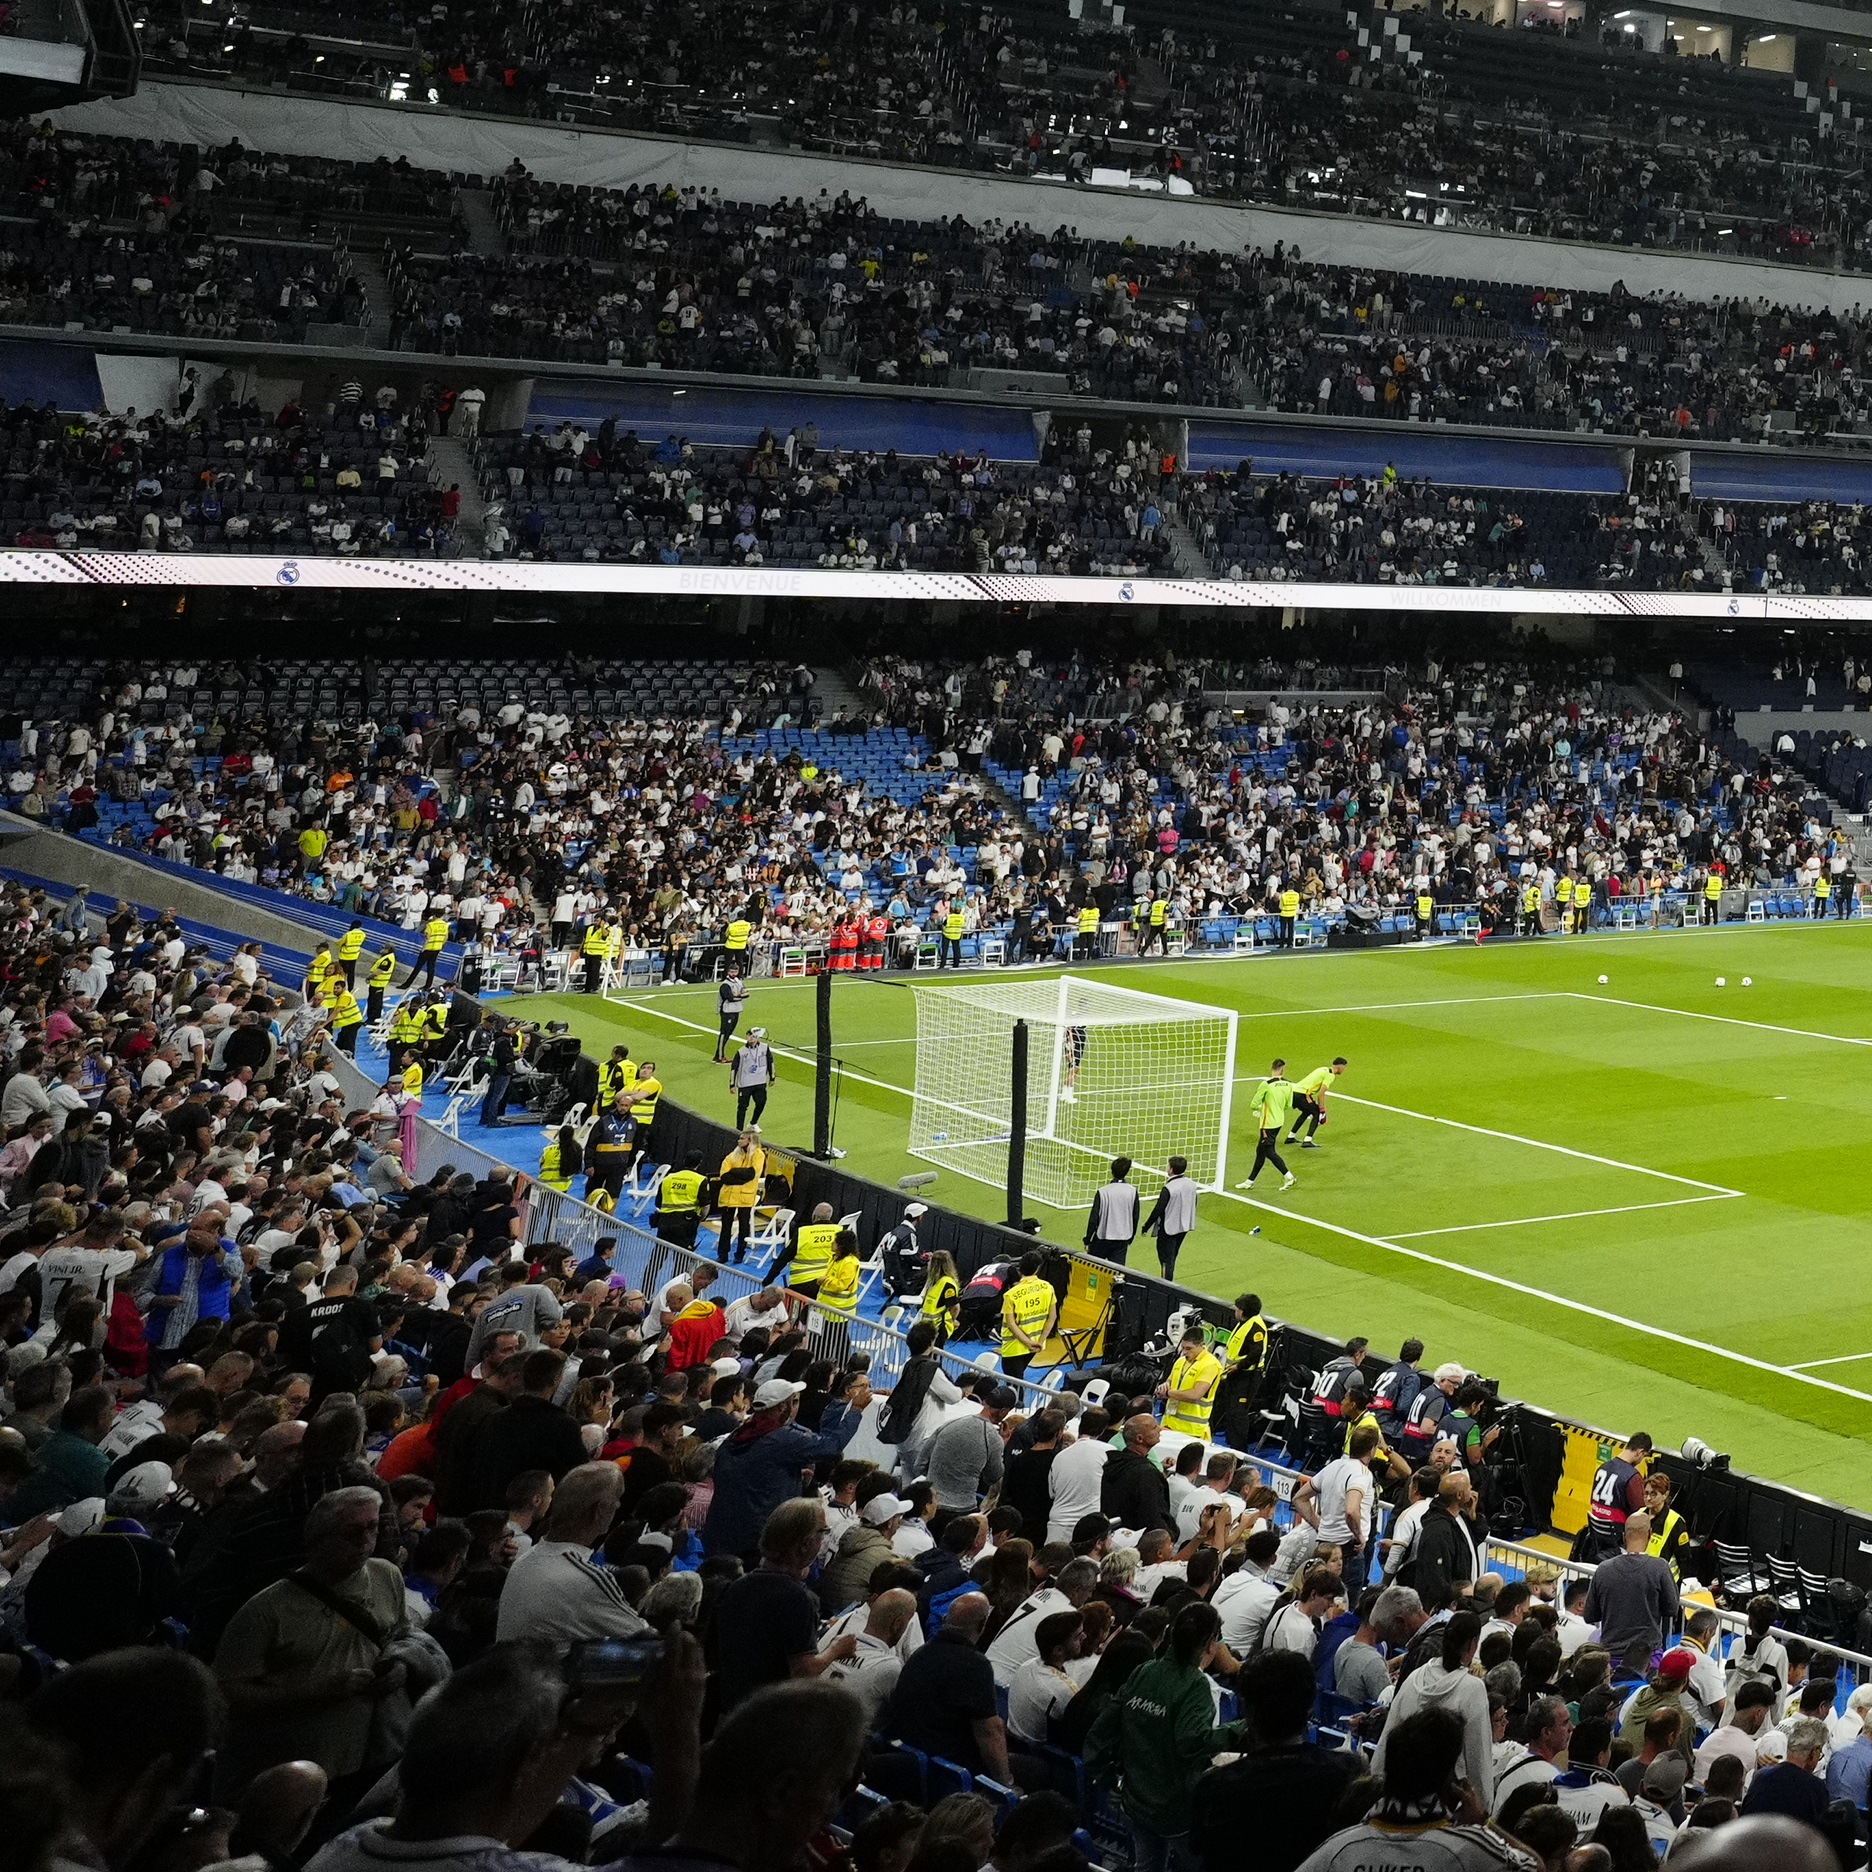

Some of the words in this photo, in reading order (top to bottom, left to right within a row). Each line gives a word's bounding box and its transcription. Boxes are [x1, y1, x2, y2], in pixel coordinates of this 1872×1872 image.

[679, 572, 802, 591] BIENVENUE
[1390, 591, 1502, 608] WILLKOMMEN
[814, 1235, 832, 1243] 203
[1013, 1283, 1048, 1301] SEGURIDAD
[311, 1303, 345, 1318] KROOS
[1024, 1297, 1041, 1309] 195
[1277, 1481, 1289, 1495] 113
[1593, 1469, 1618, 1506] 24
